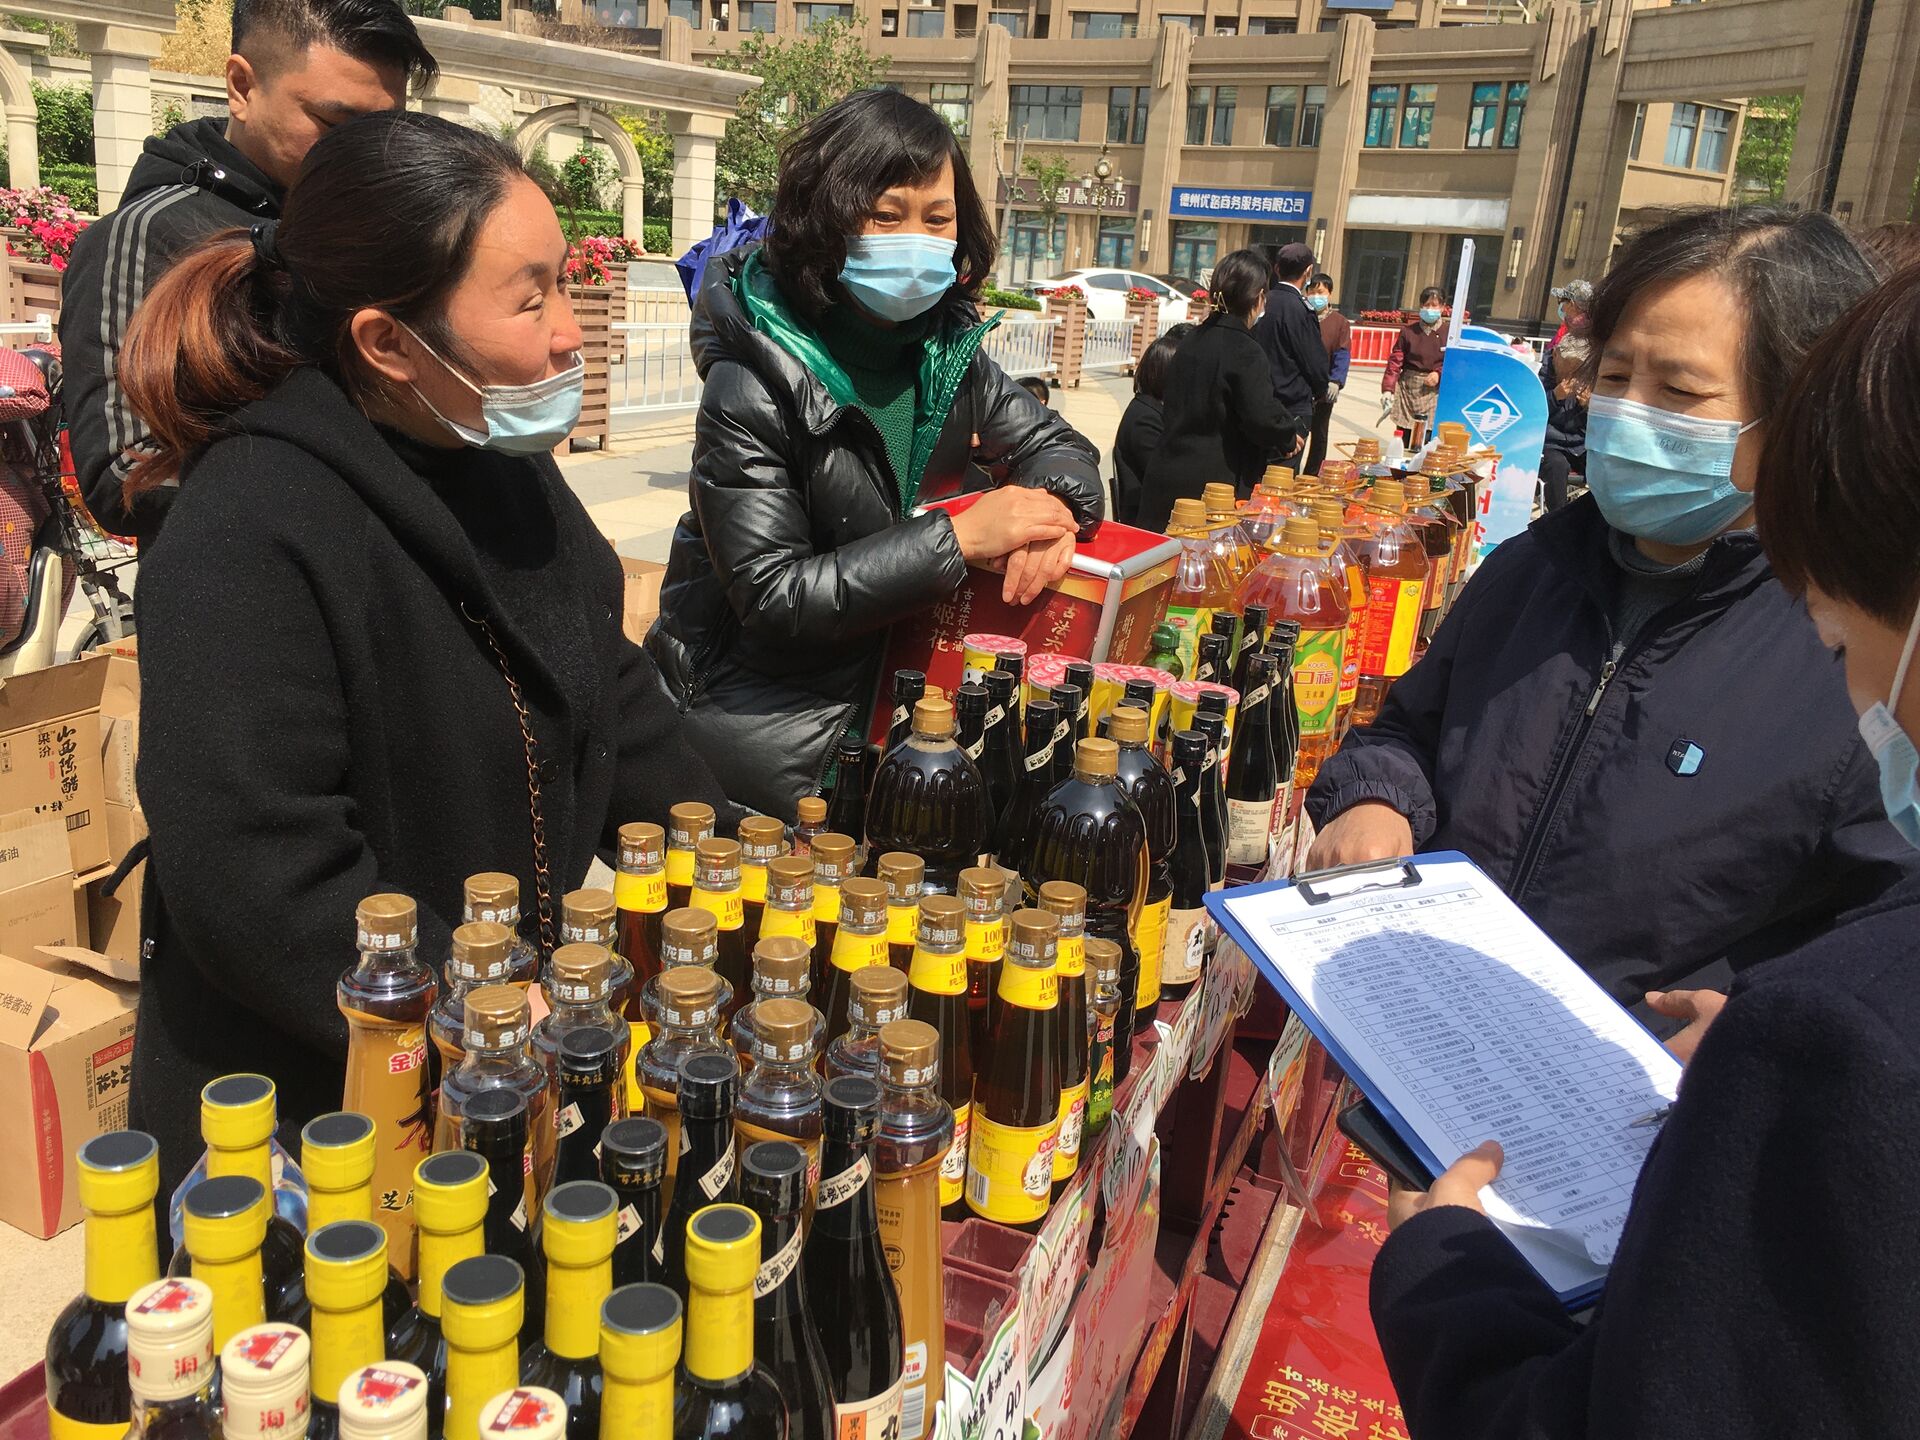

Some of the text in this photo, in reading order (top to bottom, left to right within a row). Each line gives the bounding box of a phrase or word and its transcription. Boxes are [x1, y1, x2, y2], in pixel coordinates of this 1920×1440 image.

[1179, 190, 1306, 215] 德州优路商务服务有限公司
[927, 589, 958, 653] 姬花
[1294, 671, 1334, 685] 口福
[57, 726, 78, 794] 山西陈醋
[623, 850, 658, 865] 香满园
[743, 843, 777, 857] 香满园
[922, 925, 957, 942] 香满园
